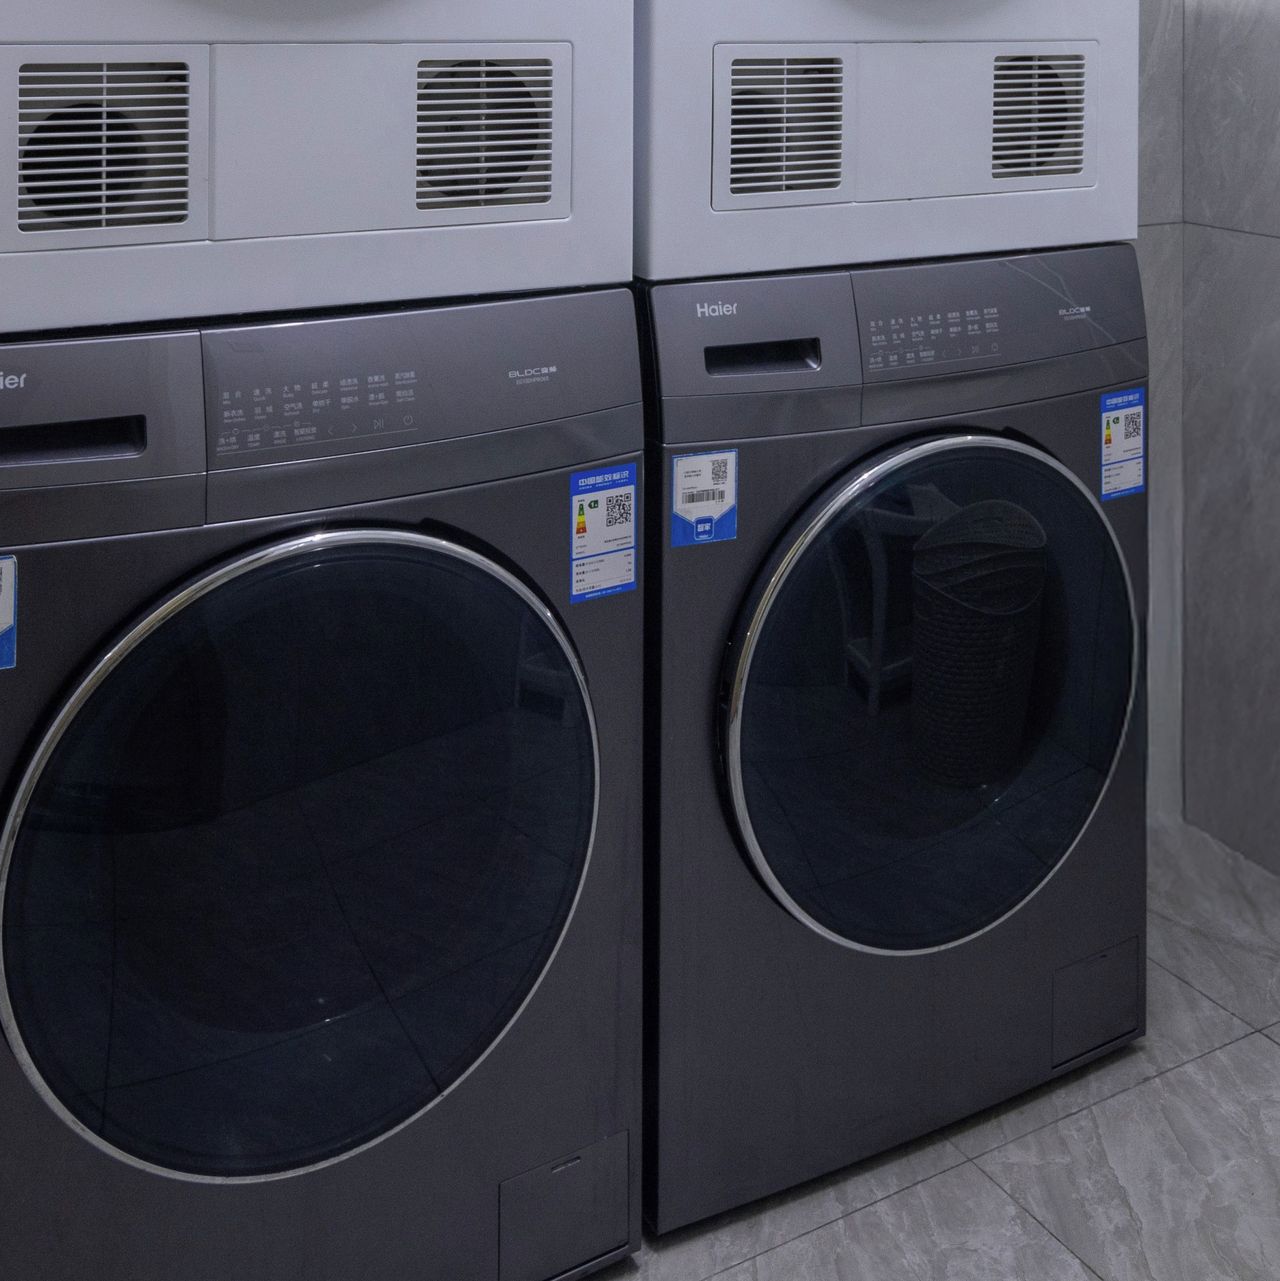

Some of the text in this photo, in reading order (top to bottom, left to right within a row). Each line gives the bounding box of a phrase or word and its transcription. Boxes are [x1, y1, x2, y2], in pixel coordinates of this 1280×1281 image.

[696, 300, 738, 318] Haier
[578, 470, 629, 486] 中国能效标识
